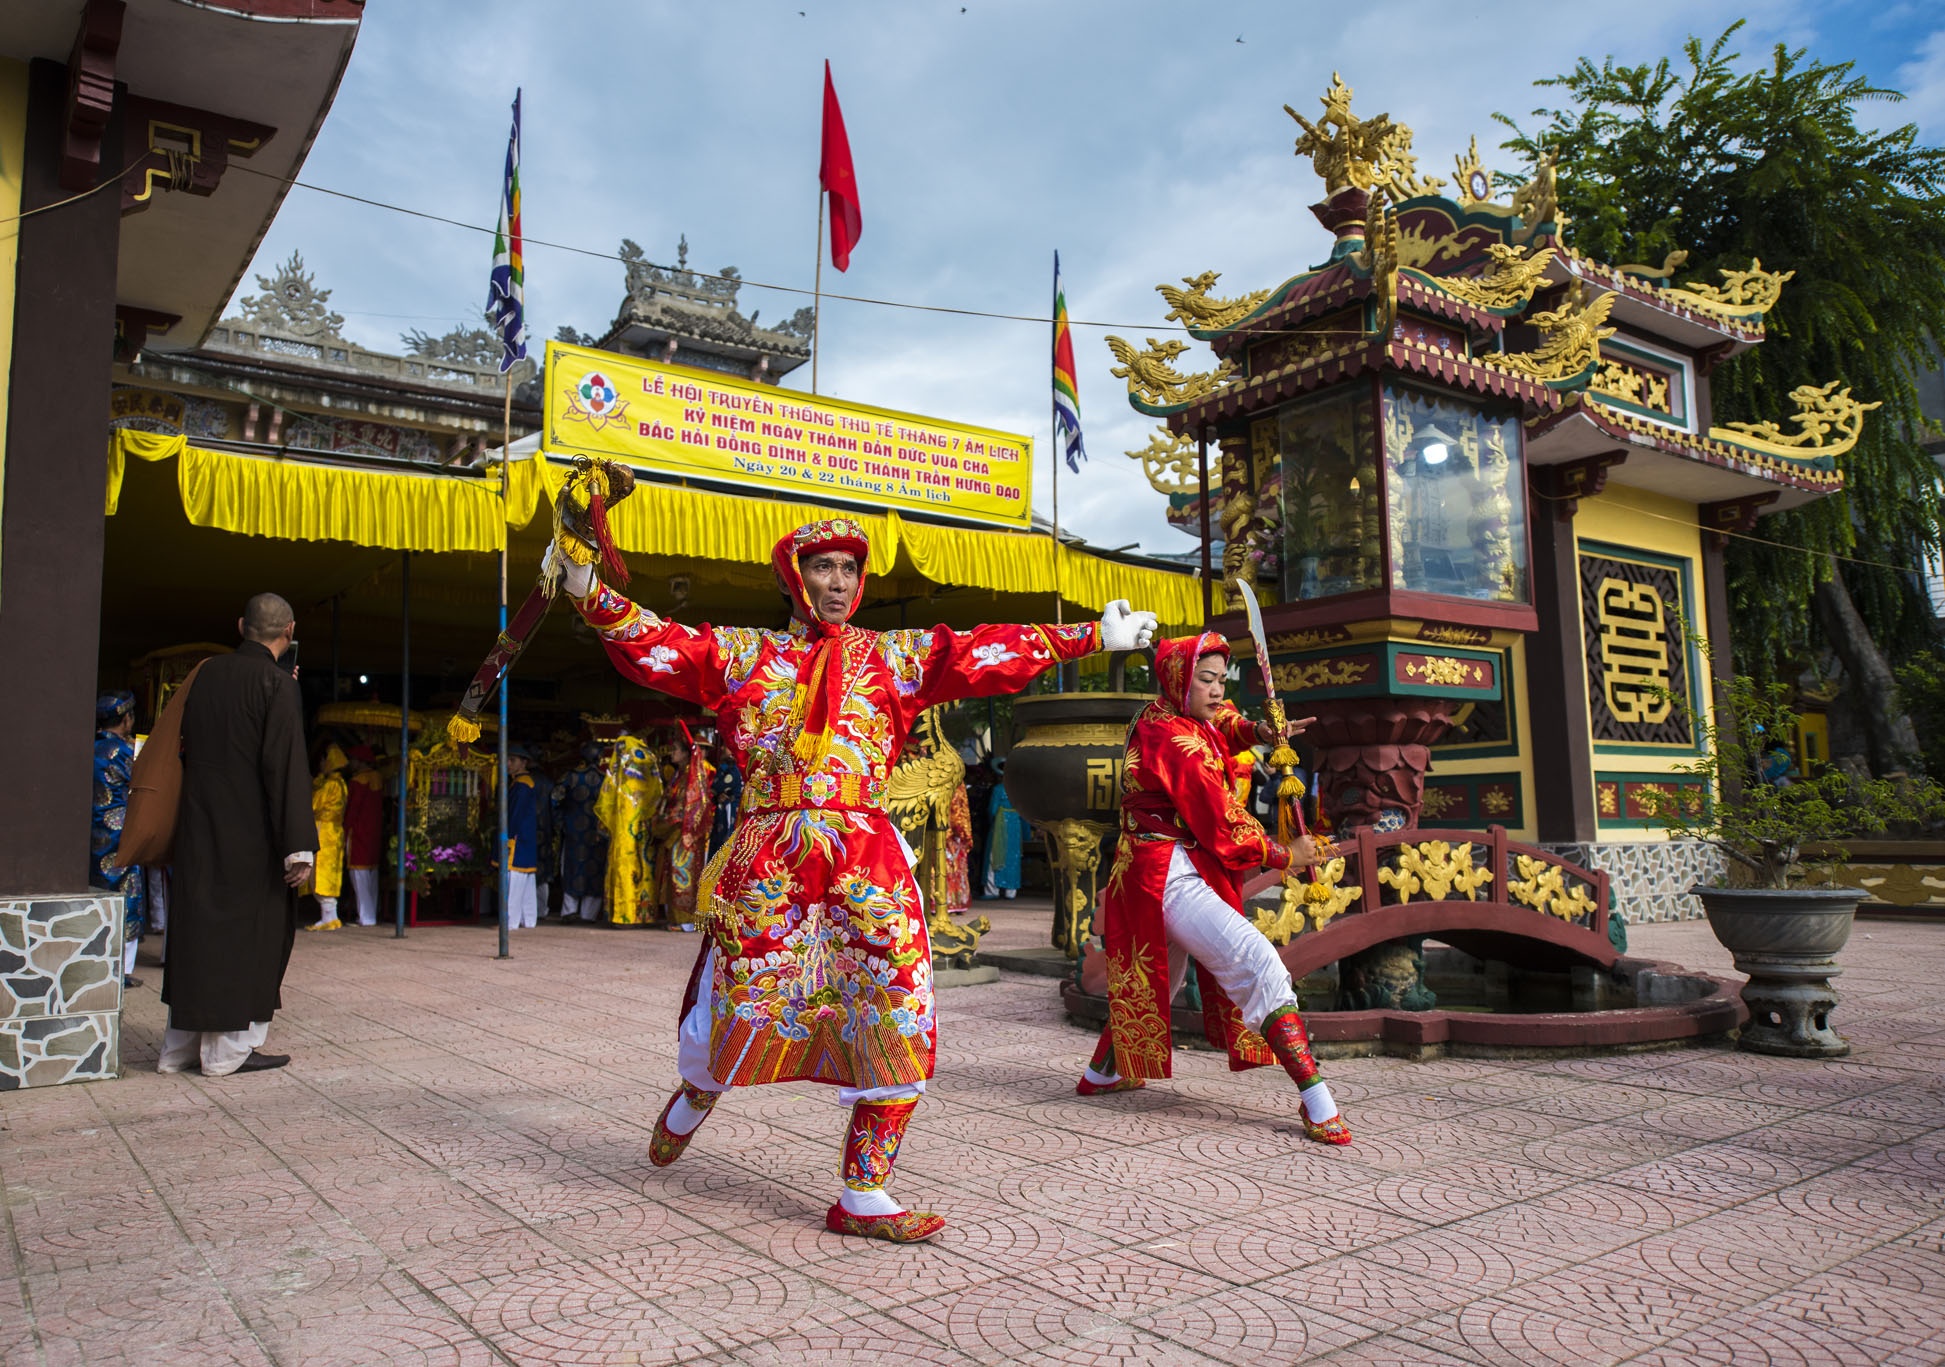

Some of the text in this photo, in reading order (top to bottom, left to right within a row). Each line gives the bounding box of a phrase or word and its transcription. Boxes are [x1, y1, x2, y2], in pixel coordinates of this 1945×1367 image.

[643, 375, 1019, 462] LỄ HỘI TRUYỀN THỐNG THU TẾ THÁNG 7 ÂM LỊCH
[684, 405, 989, 475] KỶ NIỆM NGÀY THÁNH ĐẢN ĐỨC VUA CHA
[639, 420, 1020, 501] BẮC HẢI ĐỒNG ĐÌNH & ĐỨC THÁNH TRẦN HƯNG ĐẠO
[733, 456, 951, 503] Ngày 20 & 22 tháng 8 Âm lịch
